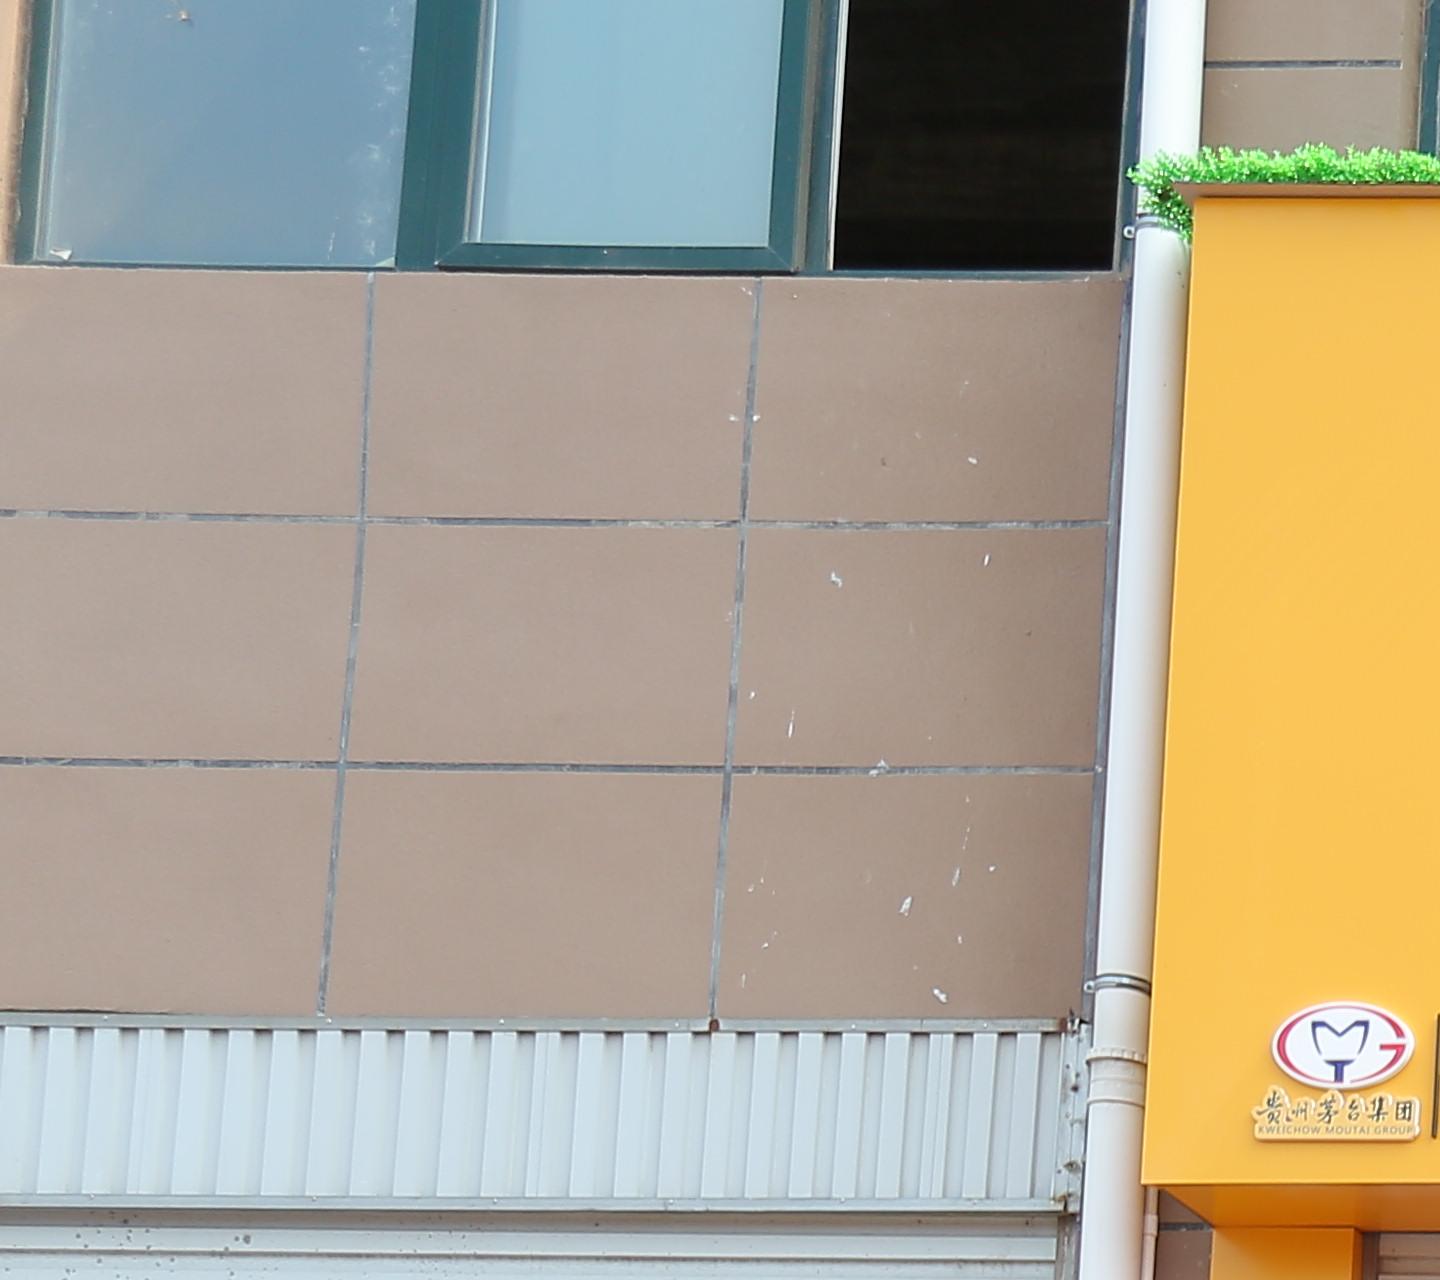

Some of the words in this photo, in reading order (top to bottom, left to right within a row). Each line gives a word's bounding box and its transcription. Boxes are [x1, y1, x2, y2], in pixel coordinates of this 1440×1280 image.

[1256, 1091, 1413, 1124] 贵州茅台集团
[1258, 1125, 1321, 1135] KWEICHOW
[1325, 1125, 1370, 1135] MOUTAI
[1374, 1125, 1413, 1135] GROUP
